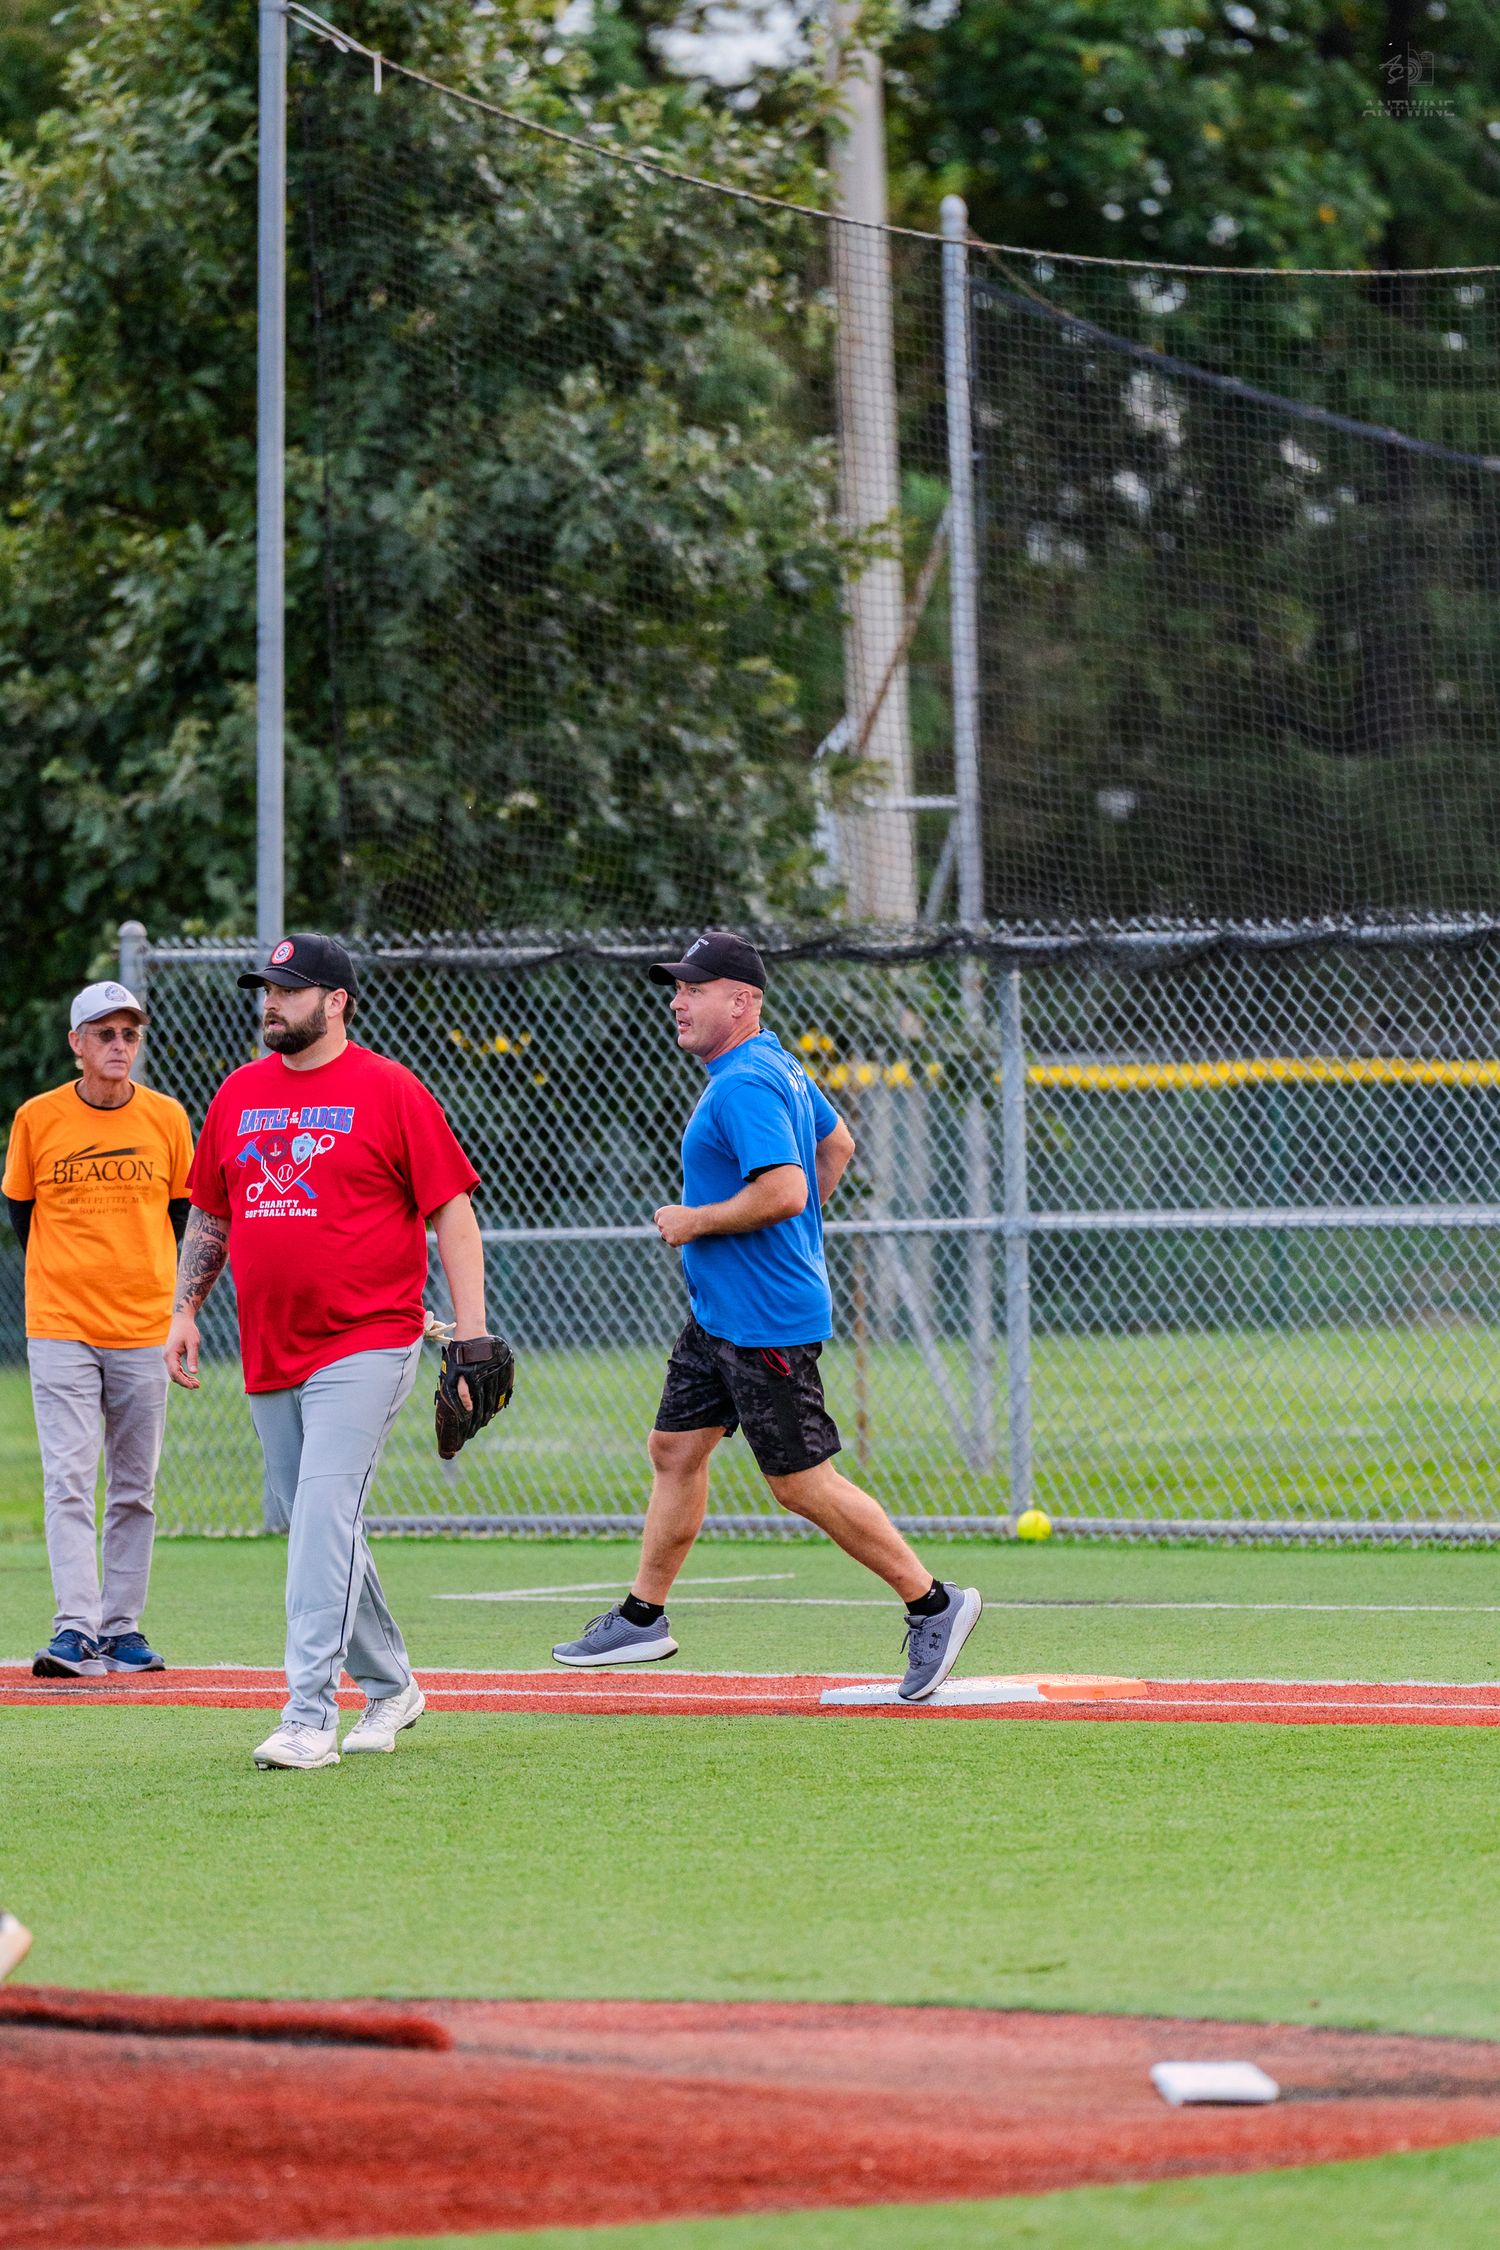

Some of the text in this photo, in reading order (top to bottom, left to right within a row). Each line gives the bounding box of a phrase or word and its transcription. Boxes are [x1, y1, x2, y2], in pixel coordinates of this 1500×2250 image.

[237, 1108, 291, 1137] BATTLE
[298, 1106, 355, 1134] BADGES
[53, 1159, 154, 1185] BEACON
[245, 1208, 318, 1219] SOFTBALL GAME
[259, 1200, 299, 1209] CHARITY
